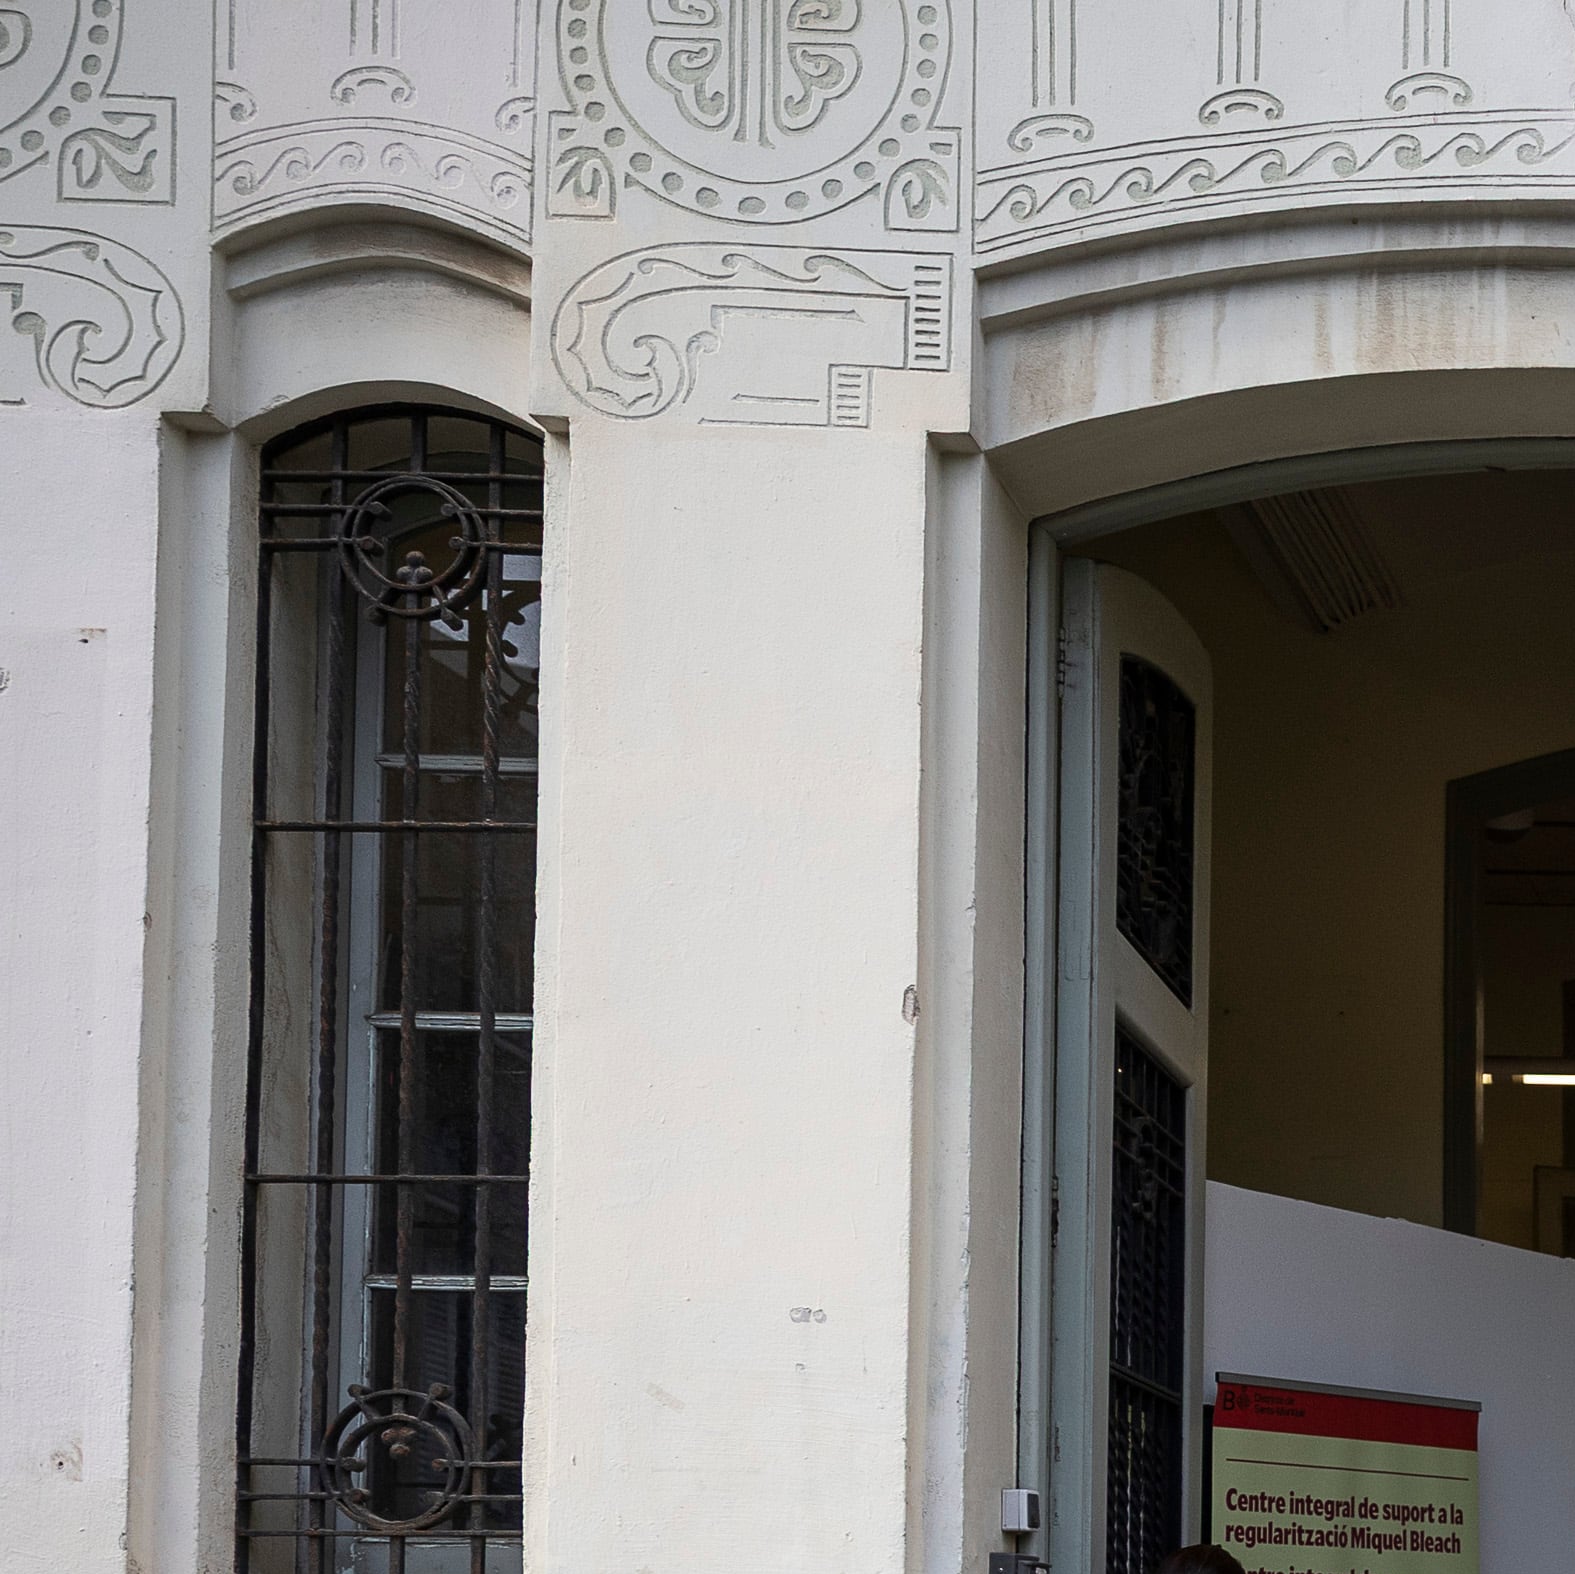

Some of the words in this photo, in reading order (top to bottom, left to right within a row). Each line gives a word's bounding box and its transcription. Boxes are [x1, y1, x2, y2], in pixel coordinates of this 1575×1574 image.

[1225, 1487, 1286, 1514] Centre
[1289, 1490, 1355, 1521] integral
[1358, 1496, 1379, 1519] de
[1382, 1503, 1435, 1526] suport
[1438, 1507, 1447, 1524] a
[1450, 1503, 1463, 1525] la
[1225, 1521, 1348, 1548] regularització
[1351, 1526, 1407, 1555] Miquel
[1410, 1530, 1461, 1554] Bleach
